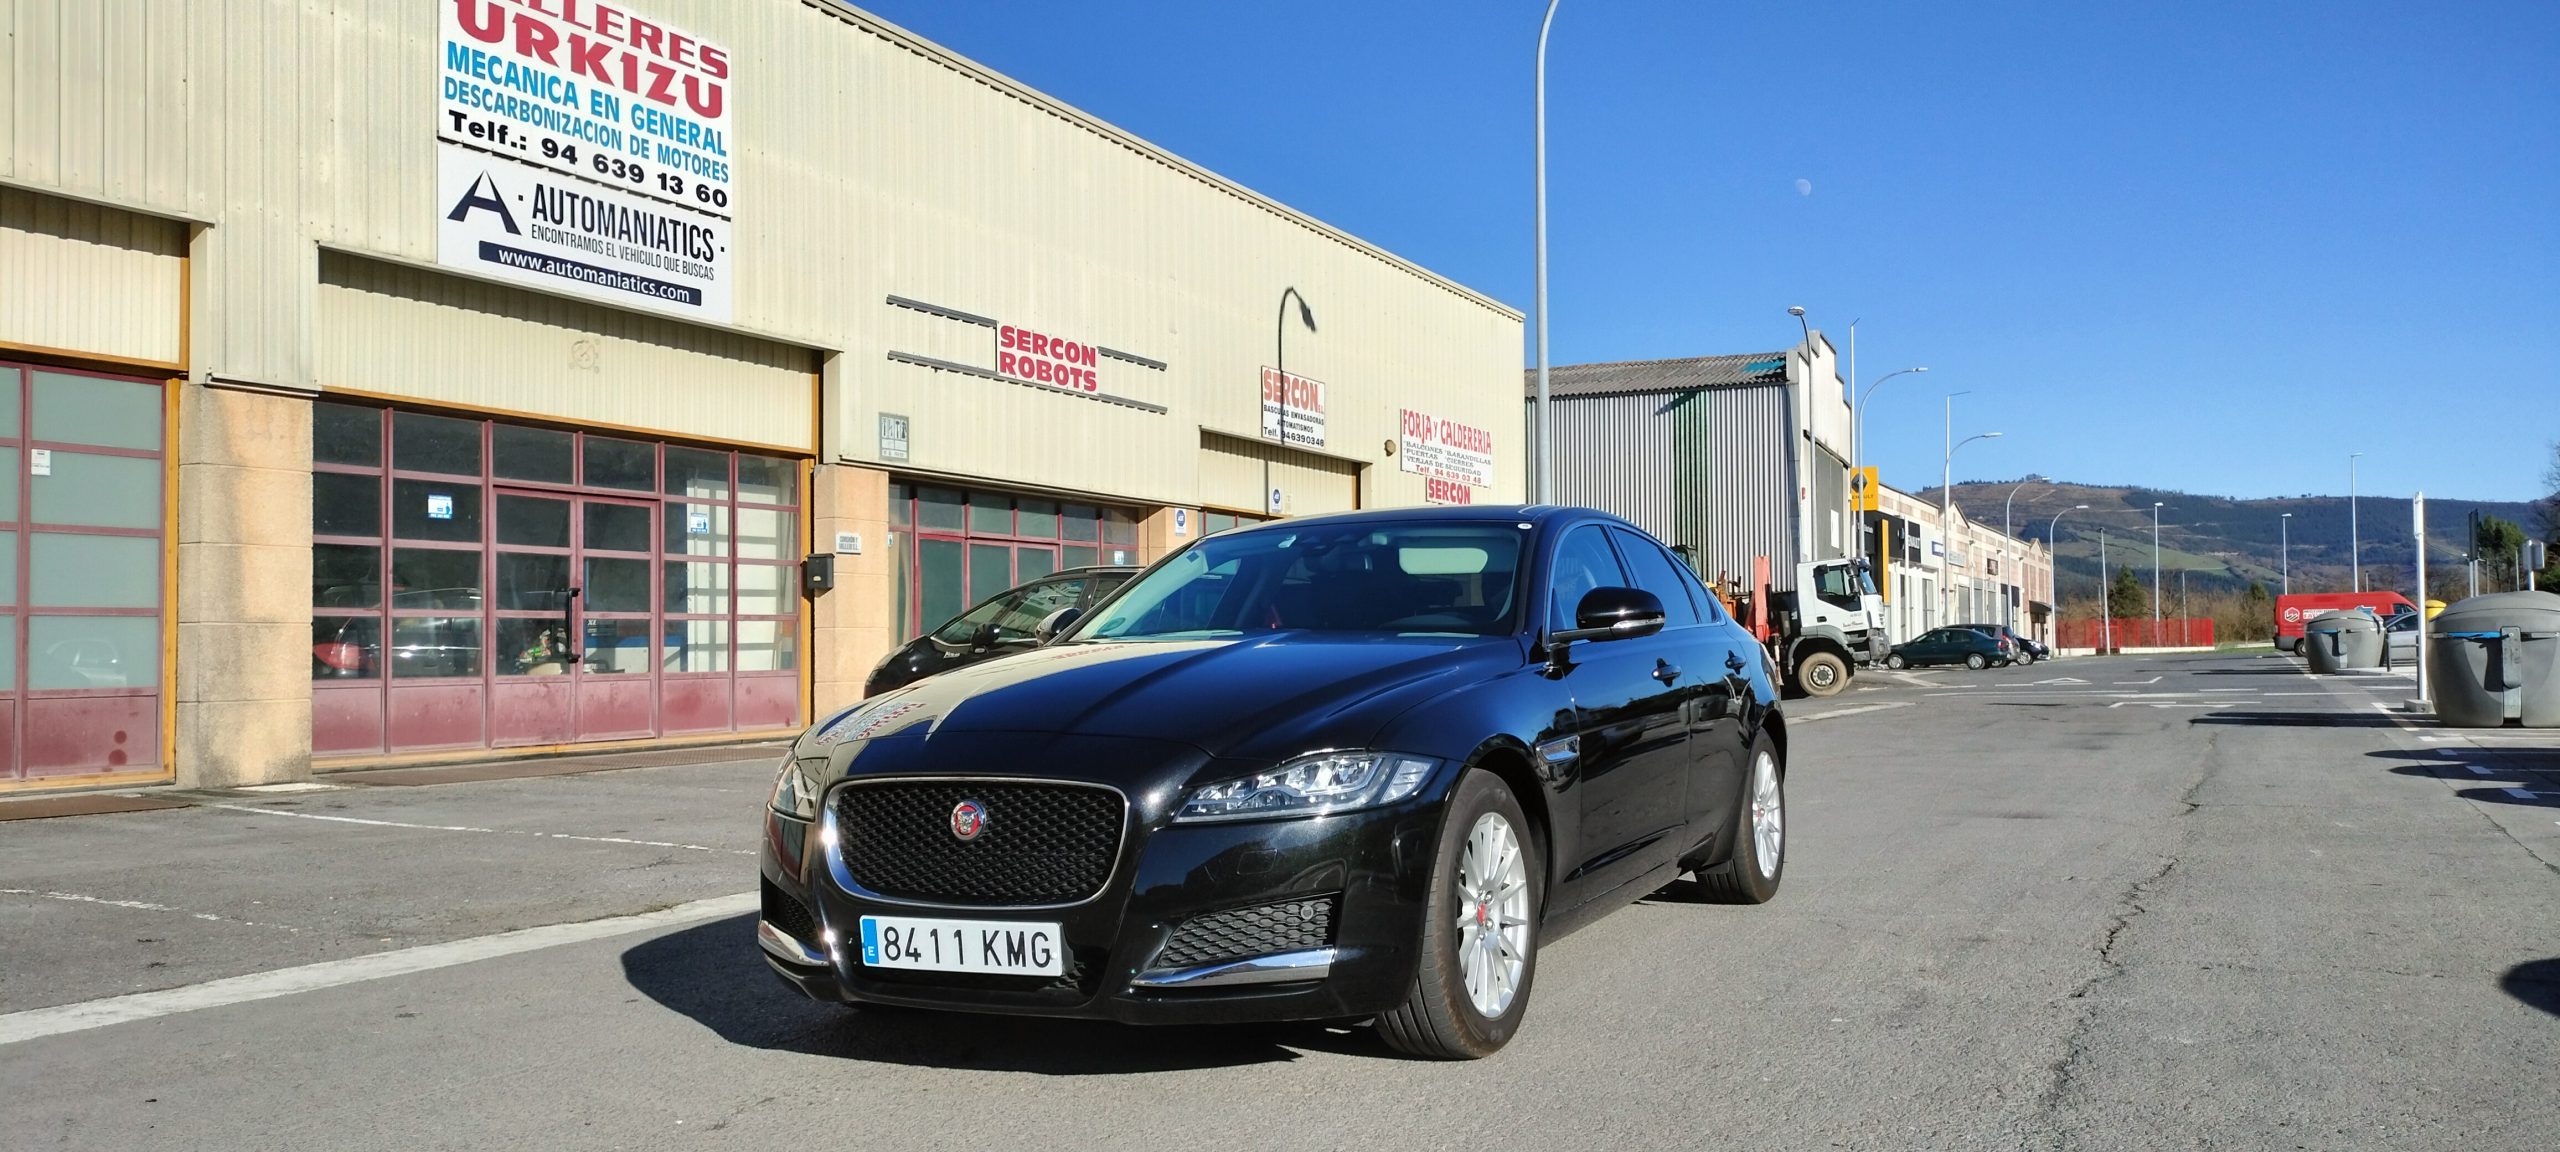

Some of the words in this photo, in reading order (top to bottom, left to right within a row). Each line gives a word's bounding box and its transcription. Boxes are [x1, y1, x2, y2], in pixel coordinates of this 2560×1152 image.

[453, 0, 723, 119] URKIZU
[508, 0, 728, 79] LERES
[447, 40, 580, 110] MECANICA
[590, 89, 620, 123] EN
[631, 103, 727, 156] GENERAL
[444, 76, 623, 151] DESCARBONIZACION
[629, 134, 650, 159] DE
[657, 143, 729, 184] MOTORES
[541, 137, 578, 165] 94
[592, 153, 645, 184] 639
[657, 172, 684, 195] 13
[695, 184, 728, 208] 60
[532, 183, 715, 263] AUTOMANIATICS
[531, 224, 604, 255] ENCONTRAMOS
[606, 243, 618, 258] EL
[663, 258, 681, 275] QUE
[682, 261, 715, 281] BUSCAS
[498, 249, 690, 302] www.automaniatics.com
[1000, 325, 1096, 368] SERCON
[999, 350, 1097, 392] ROBOTS
[1263, 369, 1318, 413] SERCON
[1280, 430, 1325, 447] 946390348
[1291, 412, 1325, 426] ENVASADORAS
[1403, 408, 1432, 444] FORJA
[1440, 419, 1491, 455] CALDERERIA
[1406, 448, 1438, 460] PUERTAS
[1434, 468, 1444, 476] 94
[1446, 471, 1459, 479] 639
[1428, 477, 1471, 504] SERCON
[868, 946, 875, 956] E
[883, 926, 964, 966] 8411
[982, 929, 1051, 968] KMG
